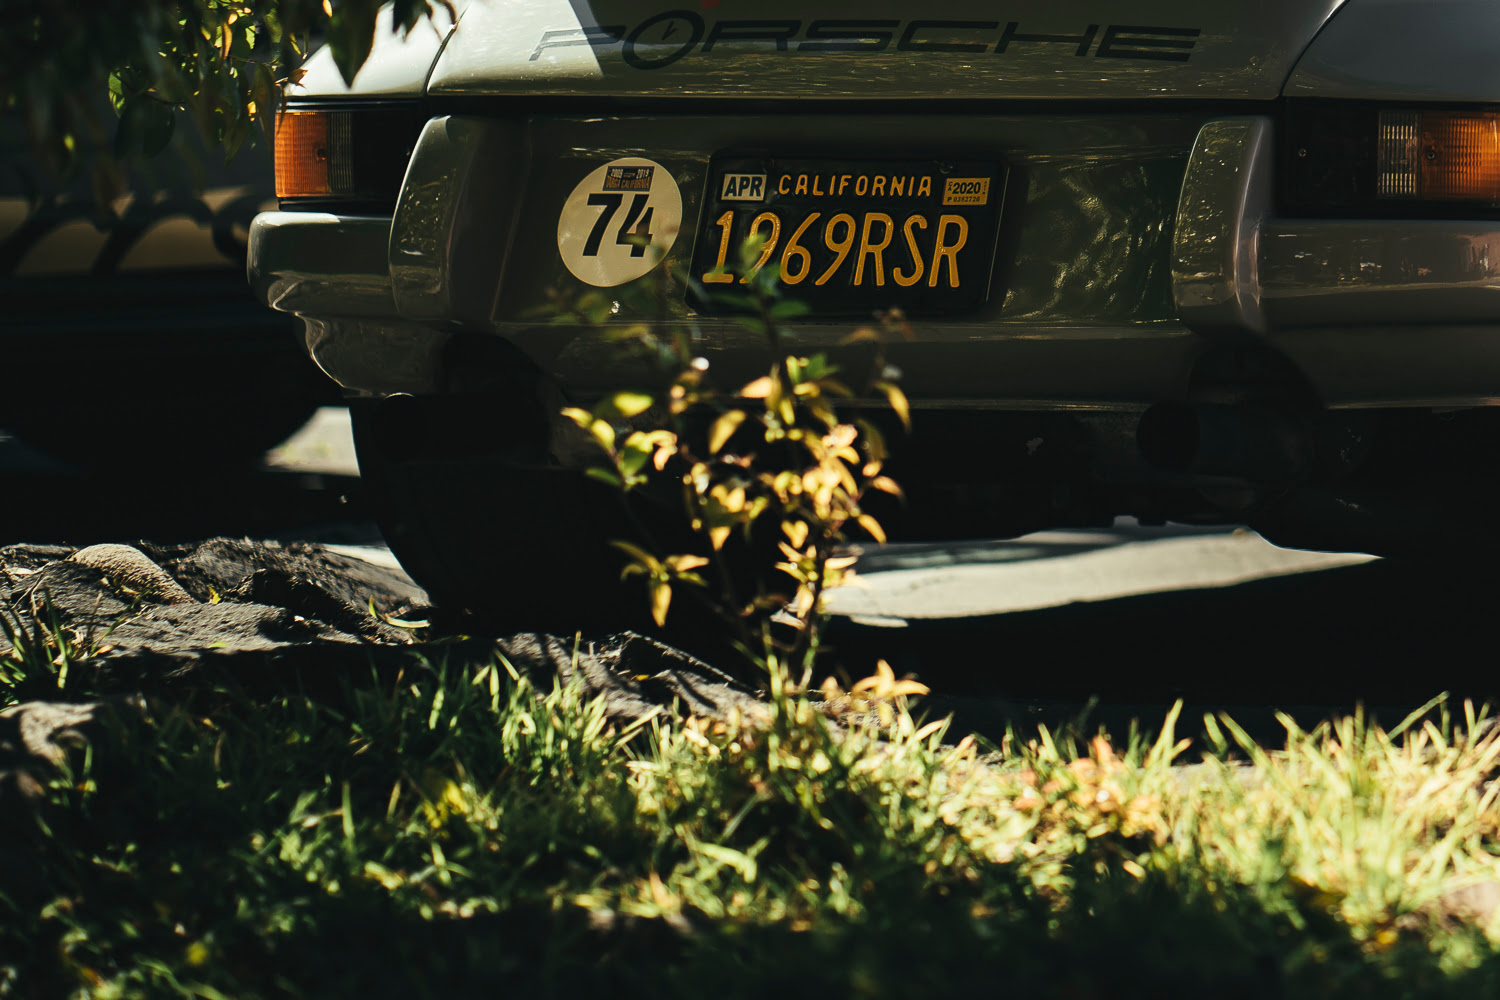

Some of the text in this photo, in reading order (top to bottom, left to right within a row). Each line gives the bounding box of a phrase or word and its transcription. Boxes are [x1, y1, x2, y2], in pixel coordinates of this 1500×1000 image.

[528, 9, 1200, 71] PORSCHE
[724, 174, 932, 197] APR CALIFORNIA
[952, 182, 980, 194] 2020
[582, 193, 654, 258] 74
[702, 210, 969, 289] 1969RSR
